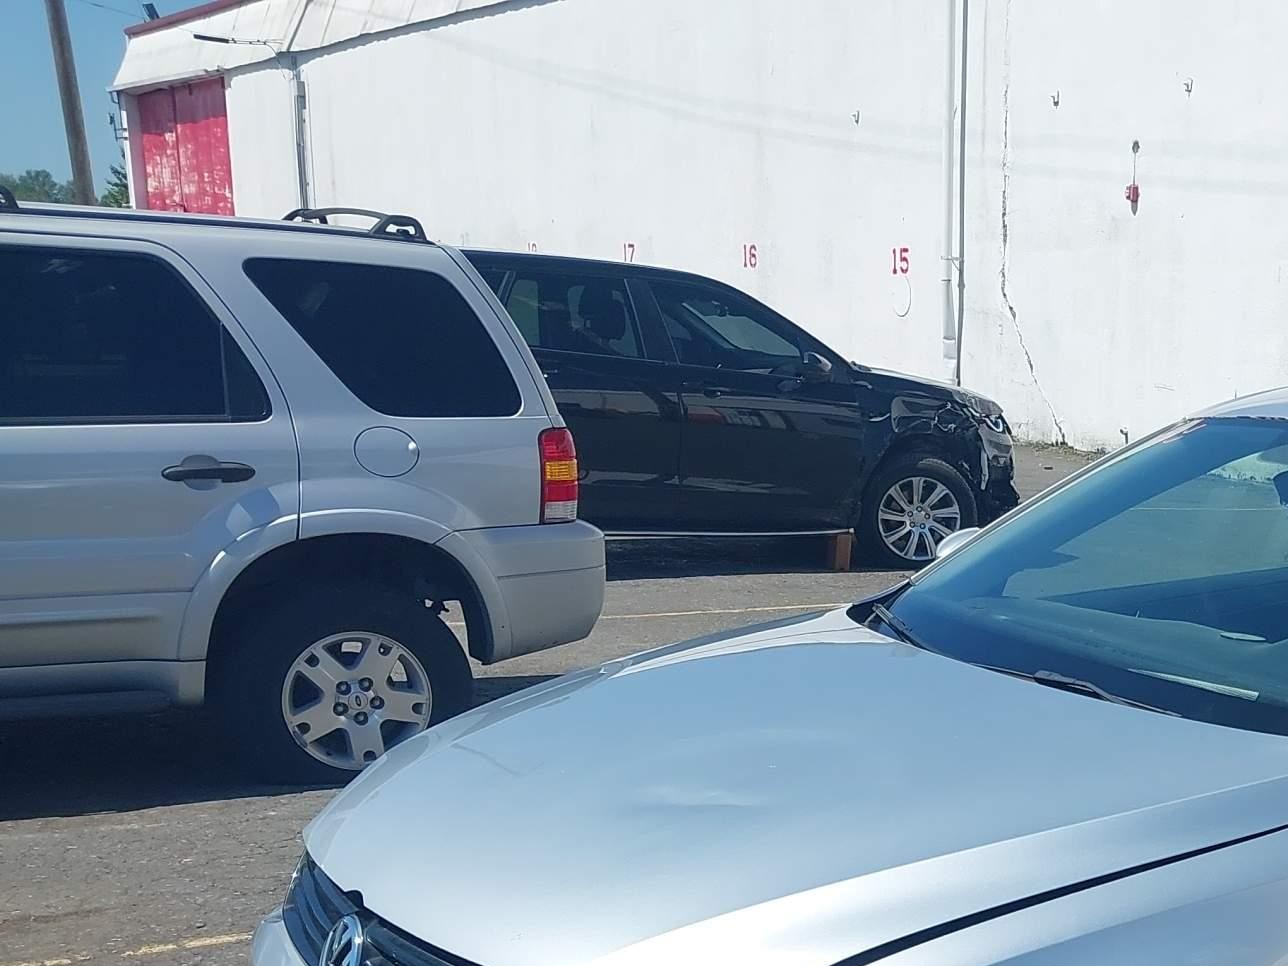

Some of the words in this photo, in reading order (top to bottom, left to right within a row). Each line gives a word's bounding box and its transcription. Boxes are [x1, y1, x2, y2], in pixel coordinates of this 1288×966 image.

[624, 243, 635, 262] 17
[743, 244, 757, 268] 16
[892, 248, 909, 274] 15
